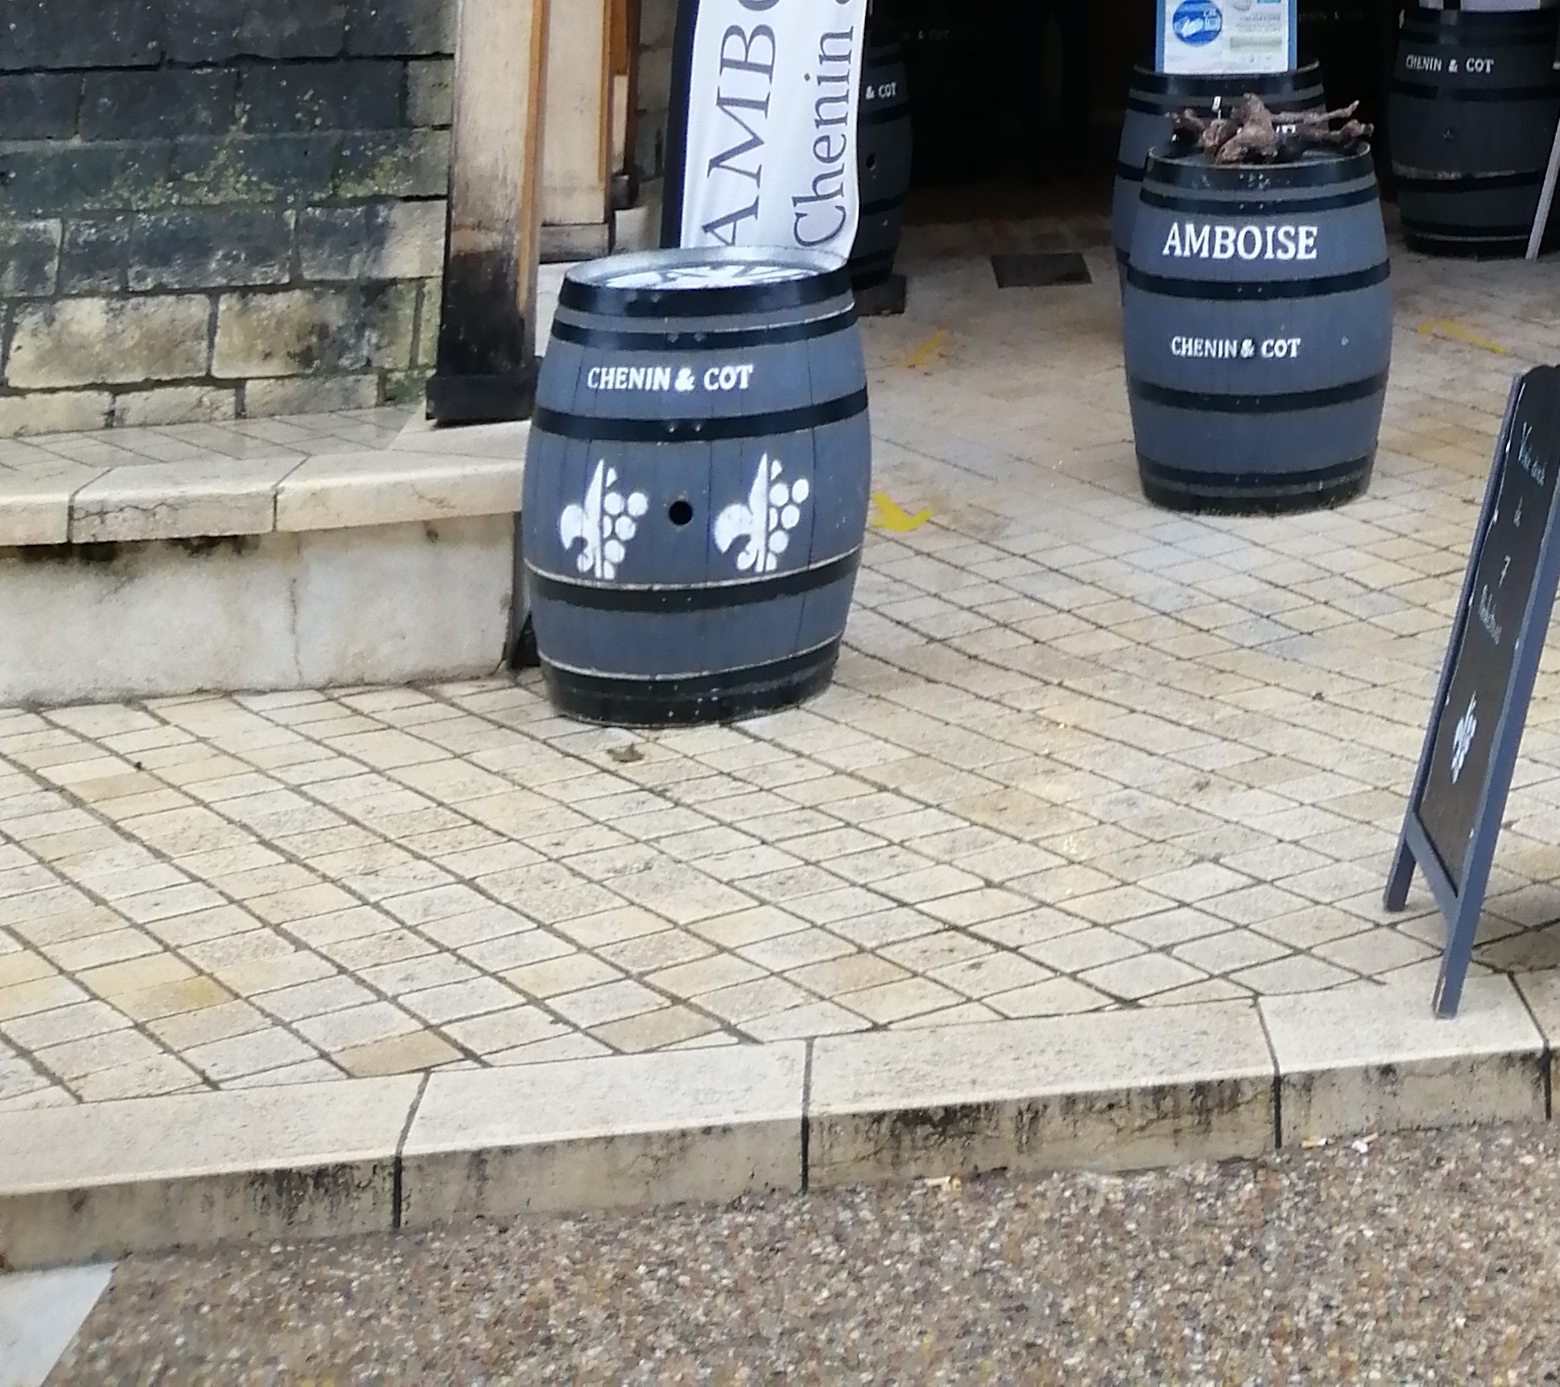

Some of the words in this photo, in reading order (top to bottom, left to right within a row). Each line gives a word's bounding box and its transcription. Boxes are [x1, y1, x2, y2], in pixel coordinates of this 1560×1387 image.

[1405, 53, 1442, 73] CHENIN
[1448, 57, 1459, 73] &
[1465, 58, 1494, 74] COT
[878, 81, 897, 99] COT
[792, 25, 855, 248] Chenin
[1162, 221, 1318, 260] AMBOISE
[1170, 336, 1237, 359] CHENIN
[1240, 339, 1255, 359] &
[1261, 338, 1301, 359] COT
[587, 366, 670, 390] CHENIN
[674, 368, 695, 391] &
[703, 364, 754, 390] COT
